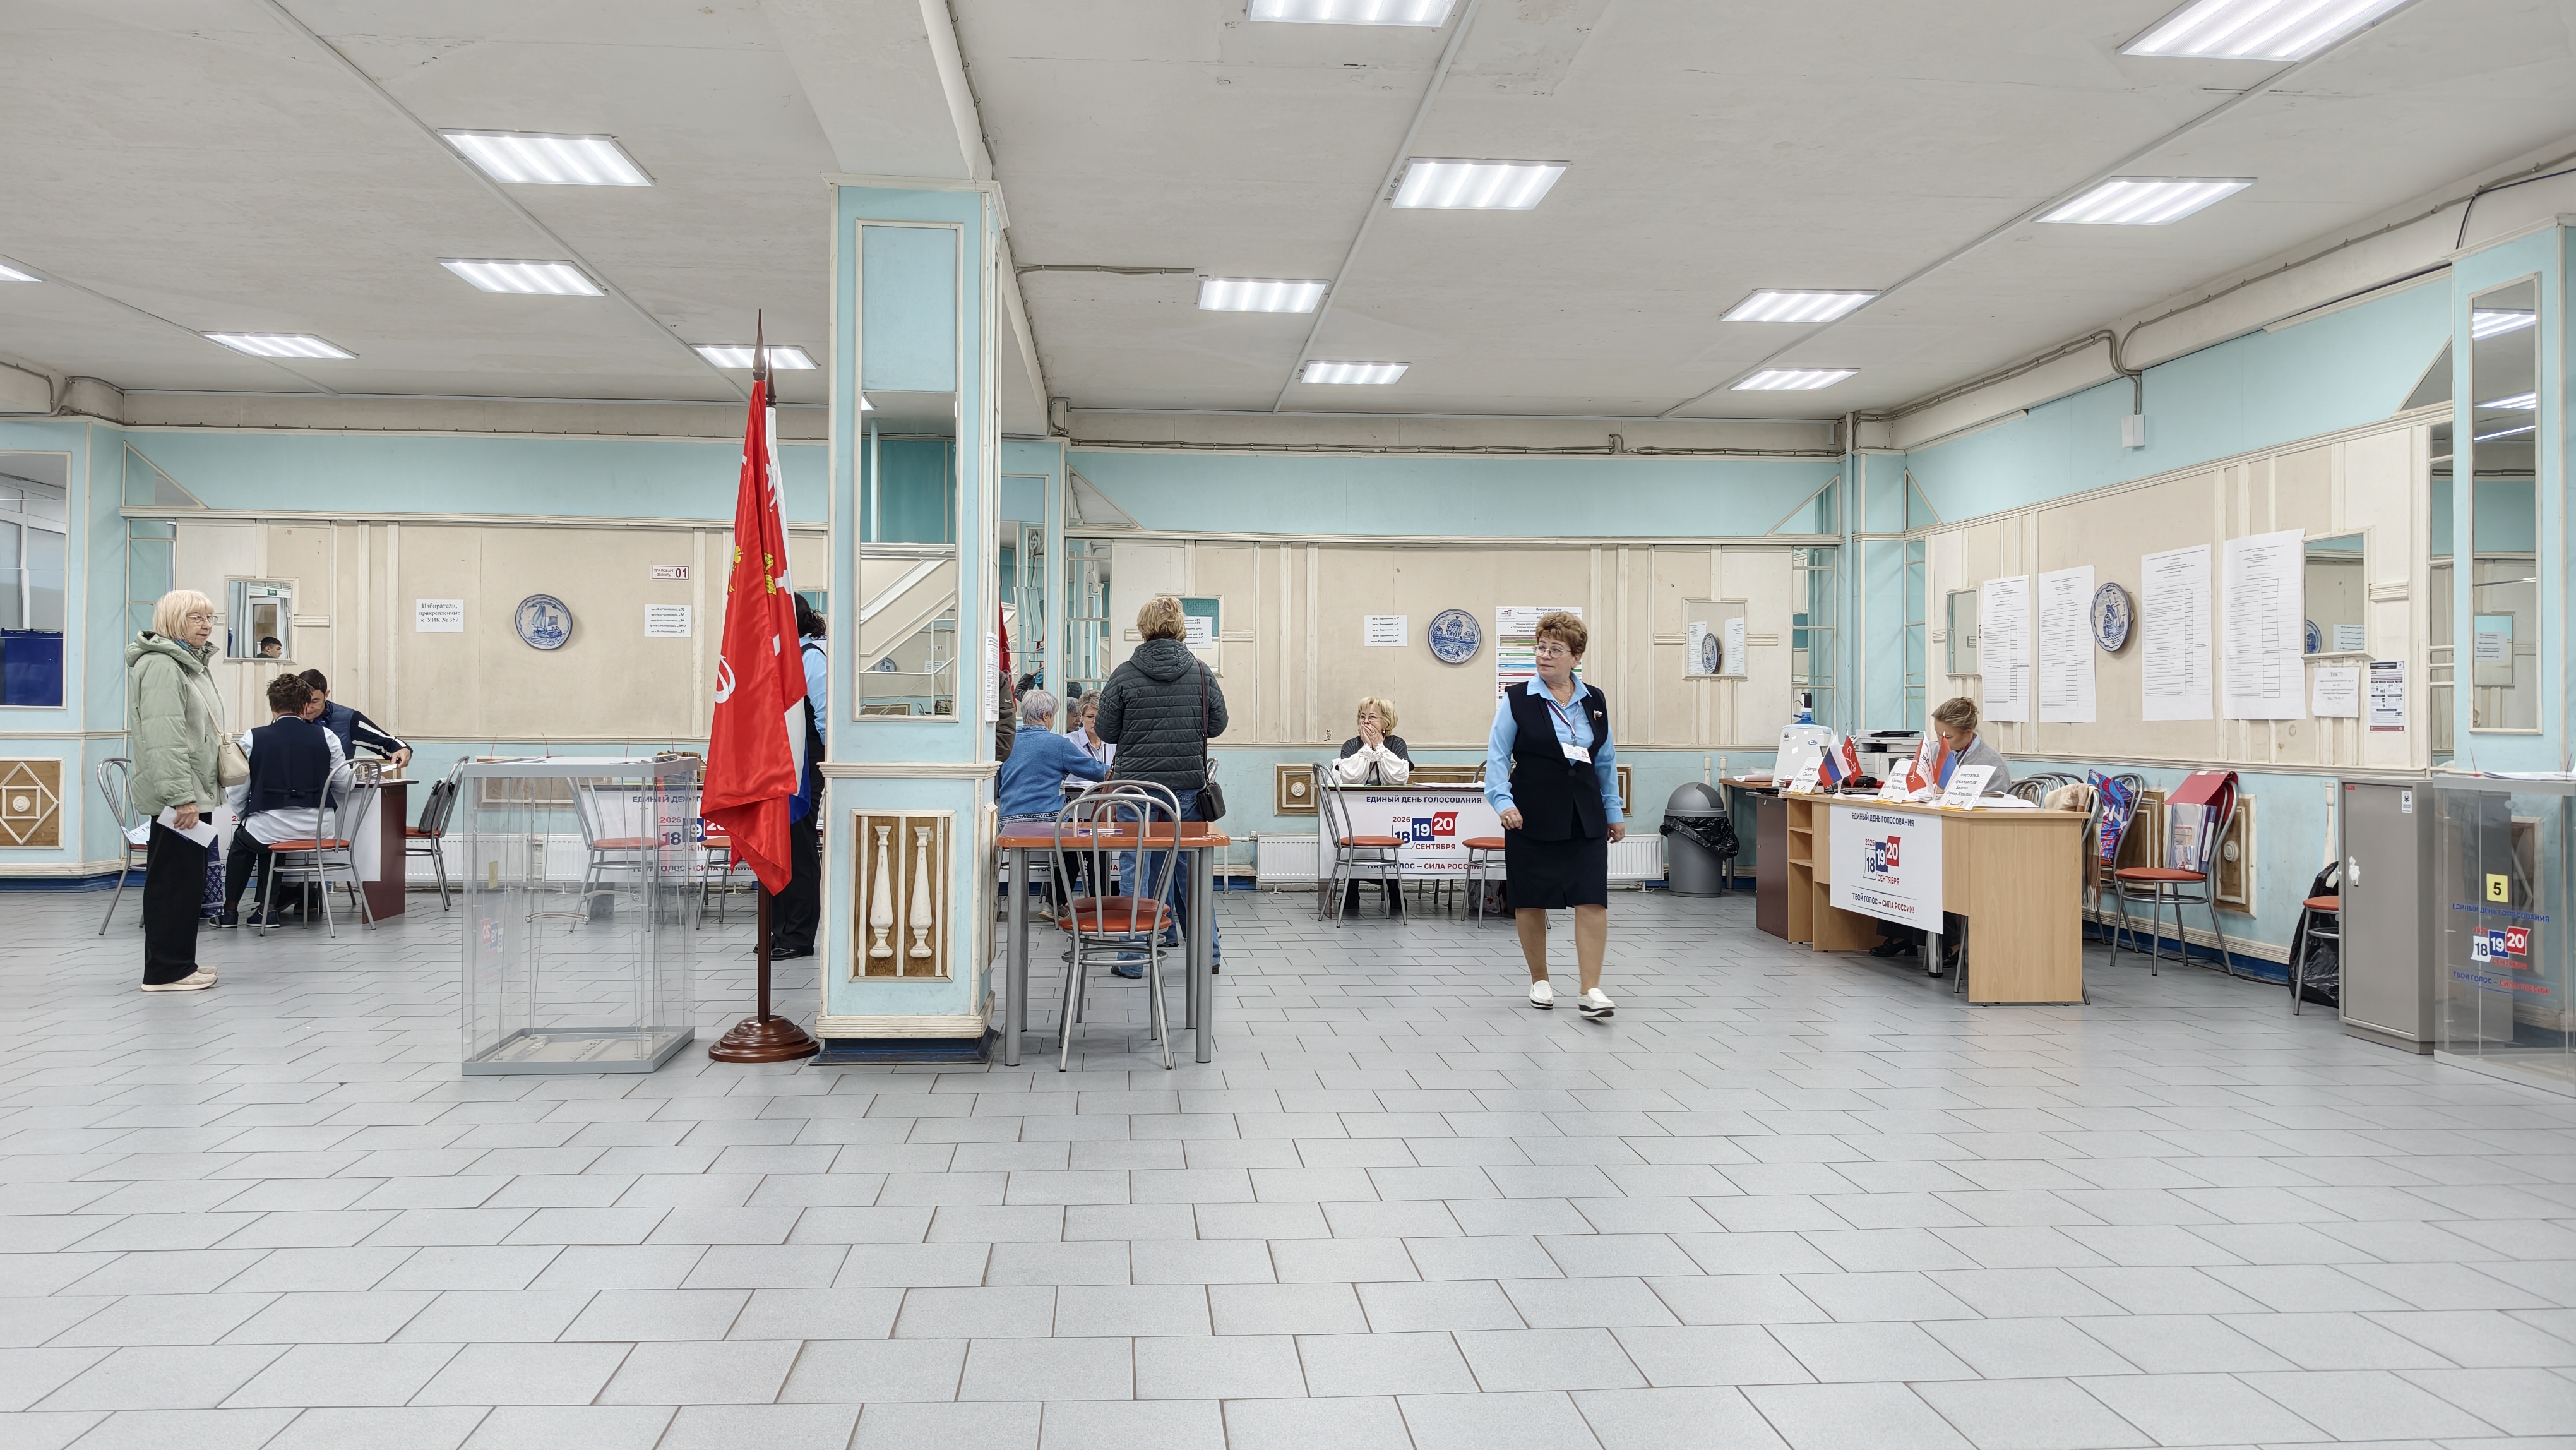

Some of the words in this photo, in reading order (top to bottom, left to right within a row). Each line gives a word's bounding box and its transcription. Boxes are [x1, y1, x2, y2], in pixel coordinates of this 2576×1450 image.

[676, 568, 686, 578] 01
[1433, 817, 1453, 830] 20
[1851, 812, 1869, 821] ЕДИНЫЙ
[1869, 815, 1881, 823] ДЕНЬ
[1881, 816, 1914, 827] ГОЛОСОВАНИЯ
[1395, 831, 1410, 844] 18
[1414, 824, 1431, 837] 19
[662, 832, 681, 846] 18
[1876, 849, 1885, 866] 19
[1887, 842, 1899, 860] 20
[1866, 856, 1875, 873] 18
[1877, 874, 1900, 885] СЕНТЯБРЯ
[2493, 882, 2501, 896] 5
[1852, 892, 1863, 902] ТВОЙ
[1864, 895, 1878, 905] ГОЛОС
[1882, 899, 1894, 909] СИЛА
[1895, 902, 1914, 914] РОССИИ!
[2452, 902, 2478, 912] ЕДИНЫЙ
[2480, 906, 2497, 915] ДЕНЬ
[2498, 909, 2550, 923] ГОЛОСОВАНИЯ
[2490, 937, 2505, 952] 19
[2507, 932, 2525, 949] 20
[2475, 942, 2488, 957] 18
[2471, 975, 2492, 984] ГОЛОС
